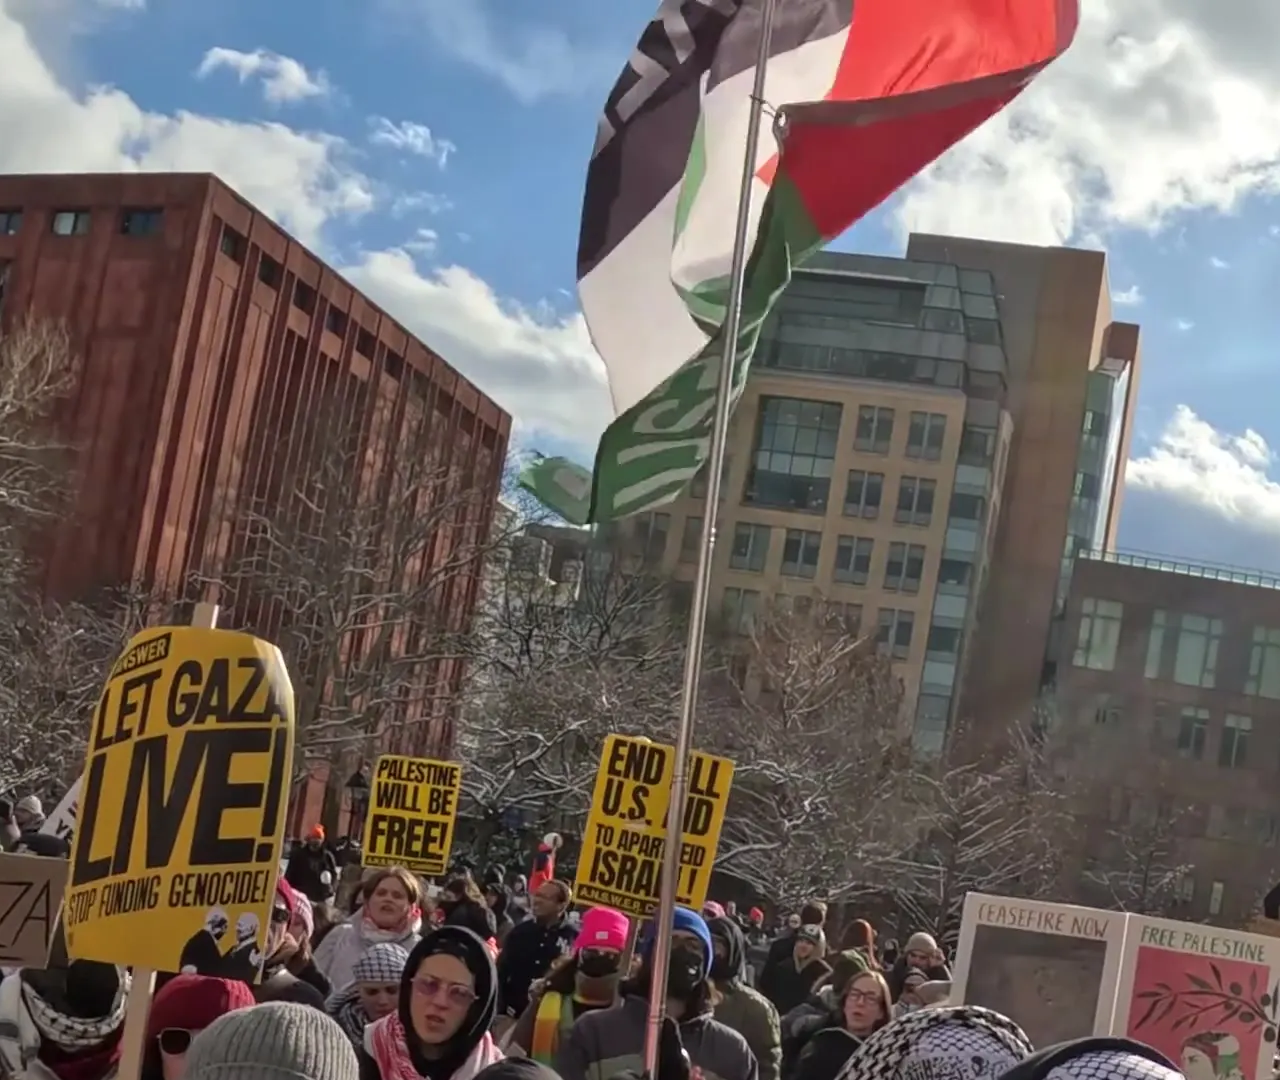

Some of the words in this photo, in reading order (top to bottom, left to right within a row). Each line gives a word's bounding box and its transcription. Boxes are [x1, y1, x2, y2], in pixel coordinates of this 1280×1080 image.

[94, 668, 162, 752] LET
[166, 658, 287, 727] GAZA
[377, 759, 458, 787] PALESTINE
[608, 738, 666, 786] END
[72, 727, 287, 886] LIVE!
[377, 781, 421, 812] WILL
[428, 788, 454, 815] BE
[602, 778, 652, 827] U.S.
[662, 796, 714, 836] ID
[369, 814, 448, 860] FREE!
[596, 823, 614, 847] TO
[68, 888, 97, 926] STOP
[99, 876, 161, 918] FUNDING
[169, 869, 270, 908] GENOCIDE!
[978, 903, 1065, 932] CEASEFIRE
[1071, 916, 1109, 939] NOW
[1141, 925, 1176, 946] FREE
[1183, 932, 1265, 962] PALESTINE
